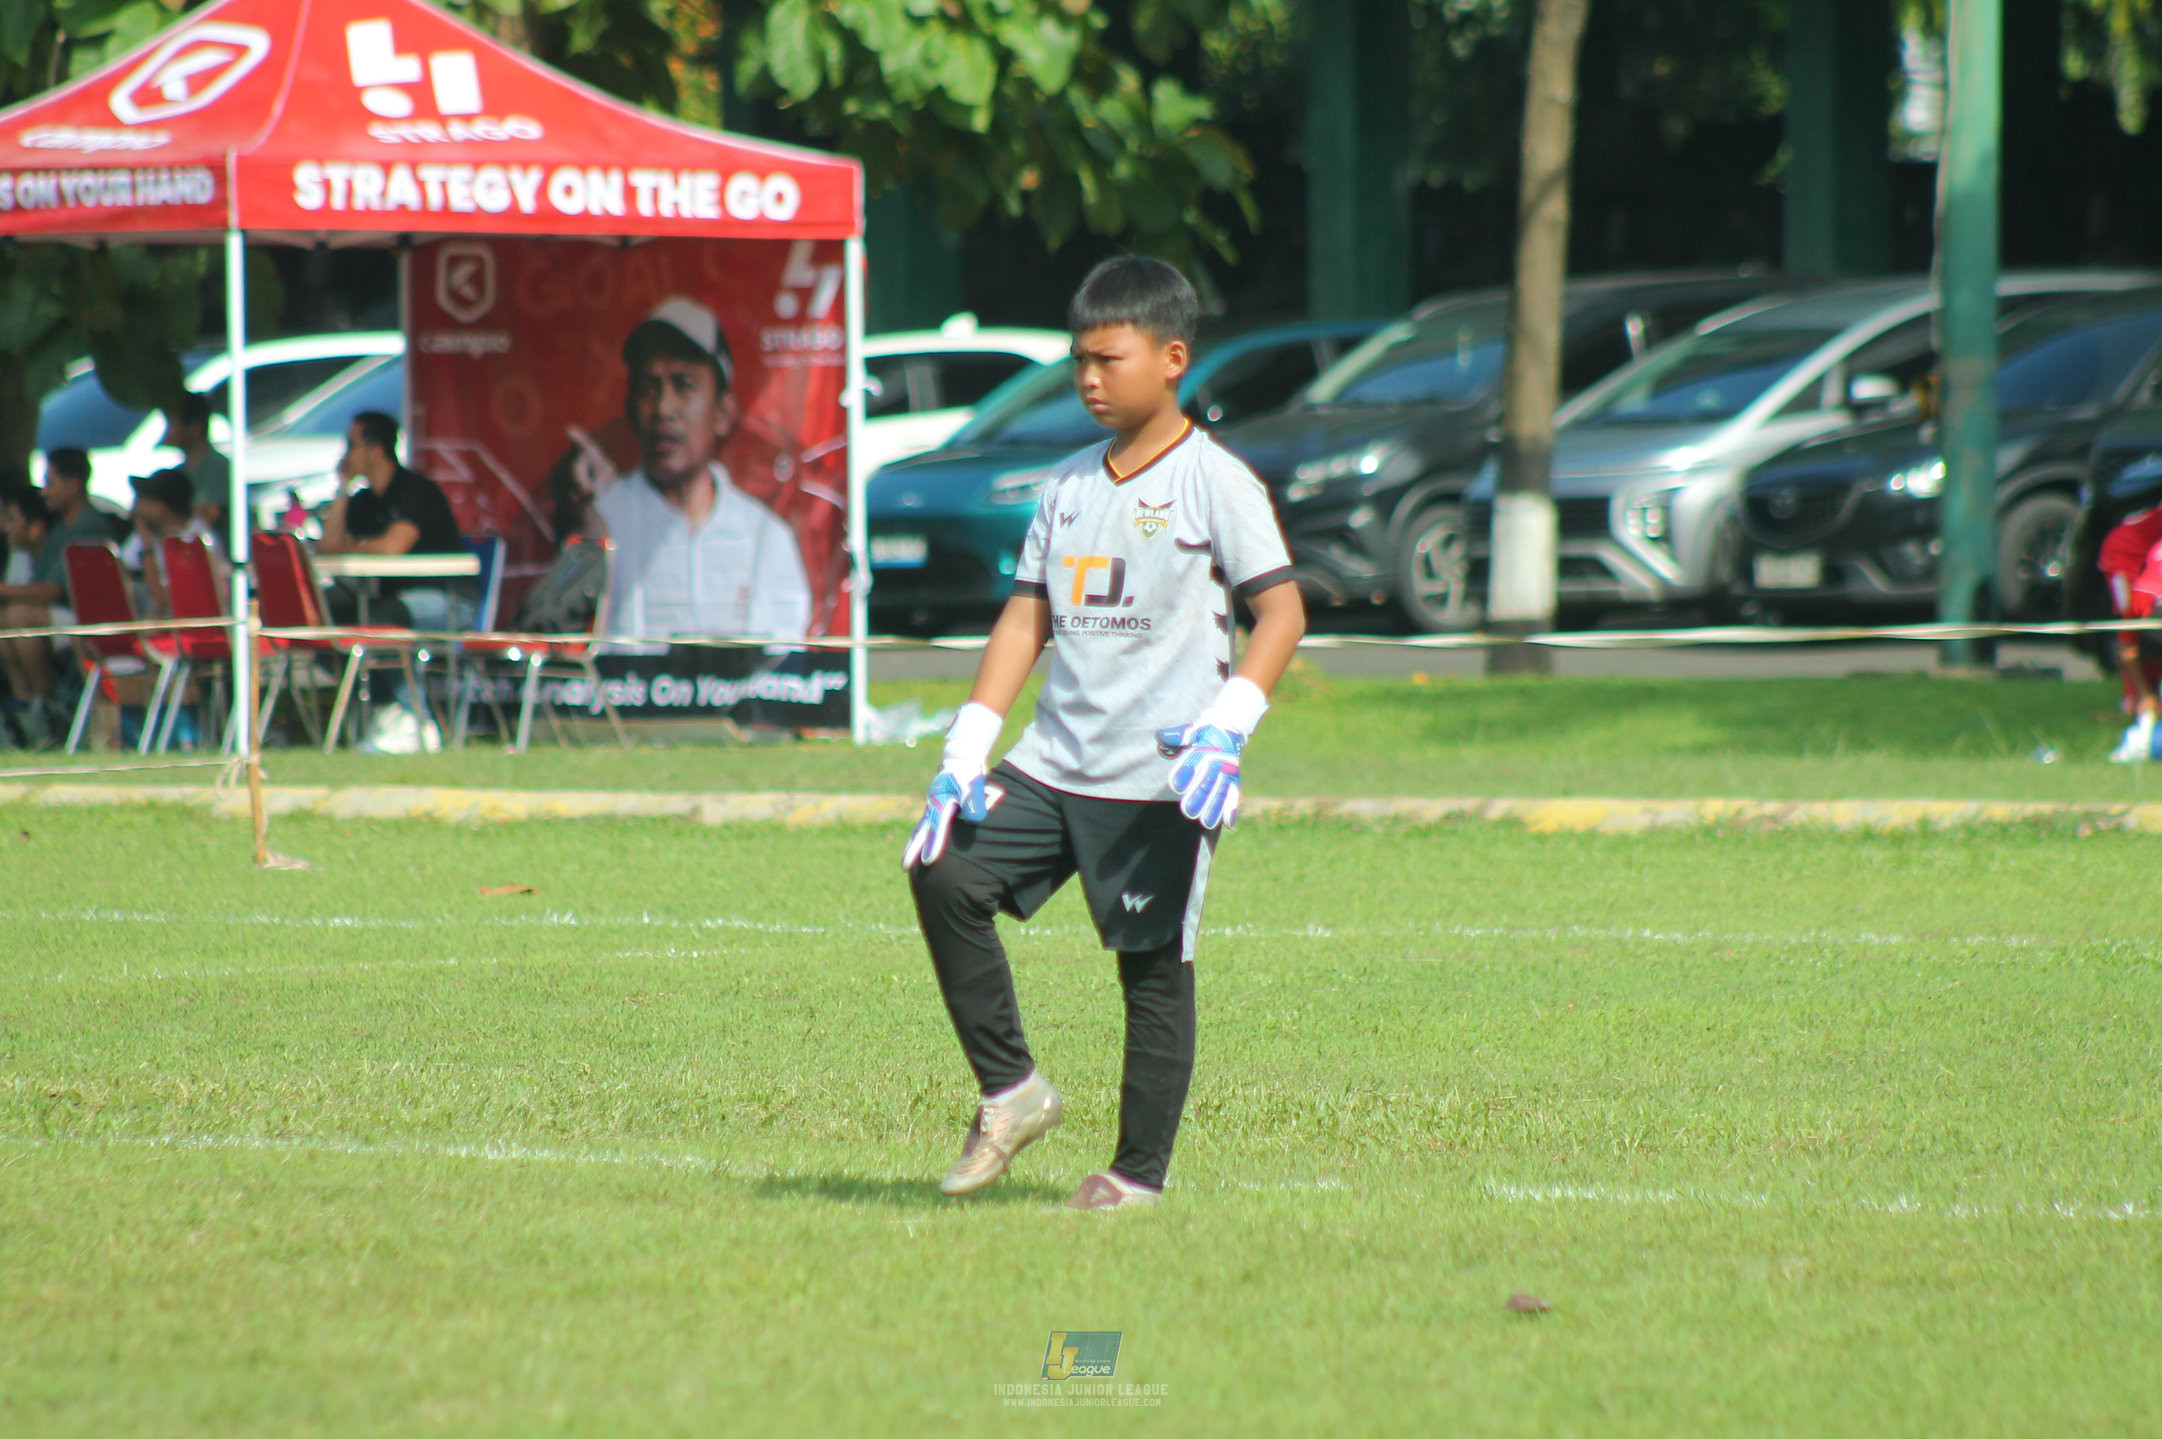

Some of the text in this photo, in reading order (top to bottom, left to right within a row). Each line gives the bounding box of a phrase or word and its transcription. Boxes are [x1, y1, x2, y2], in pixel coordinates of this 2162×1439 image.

[366, 115, 544, 144] STRAGO
[16, 171, 59, 209] ON
[60, 169, 134, 208] YOUR
[135, 166, 215, 206] HAND
[292, 160, 801, 222] STRATEGY ON THE GO
[1052, 614, 1152, 631] HE OETOMOS
[650, 673, 695, 707] On
